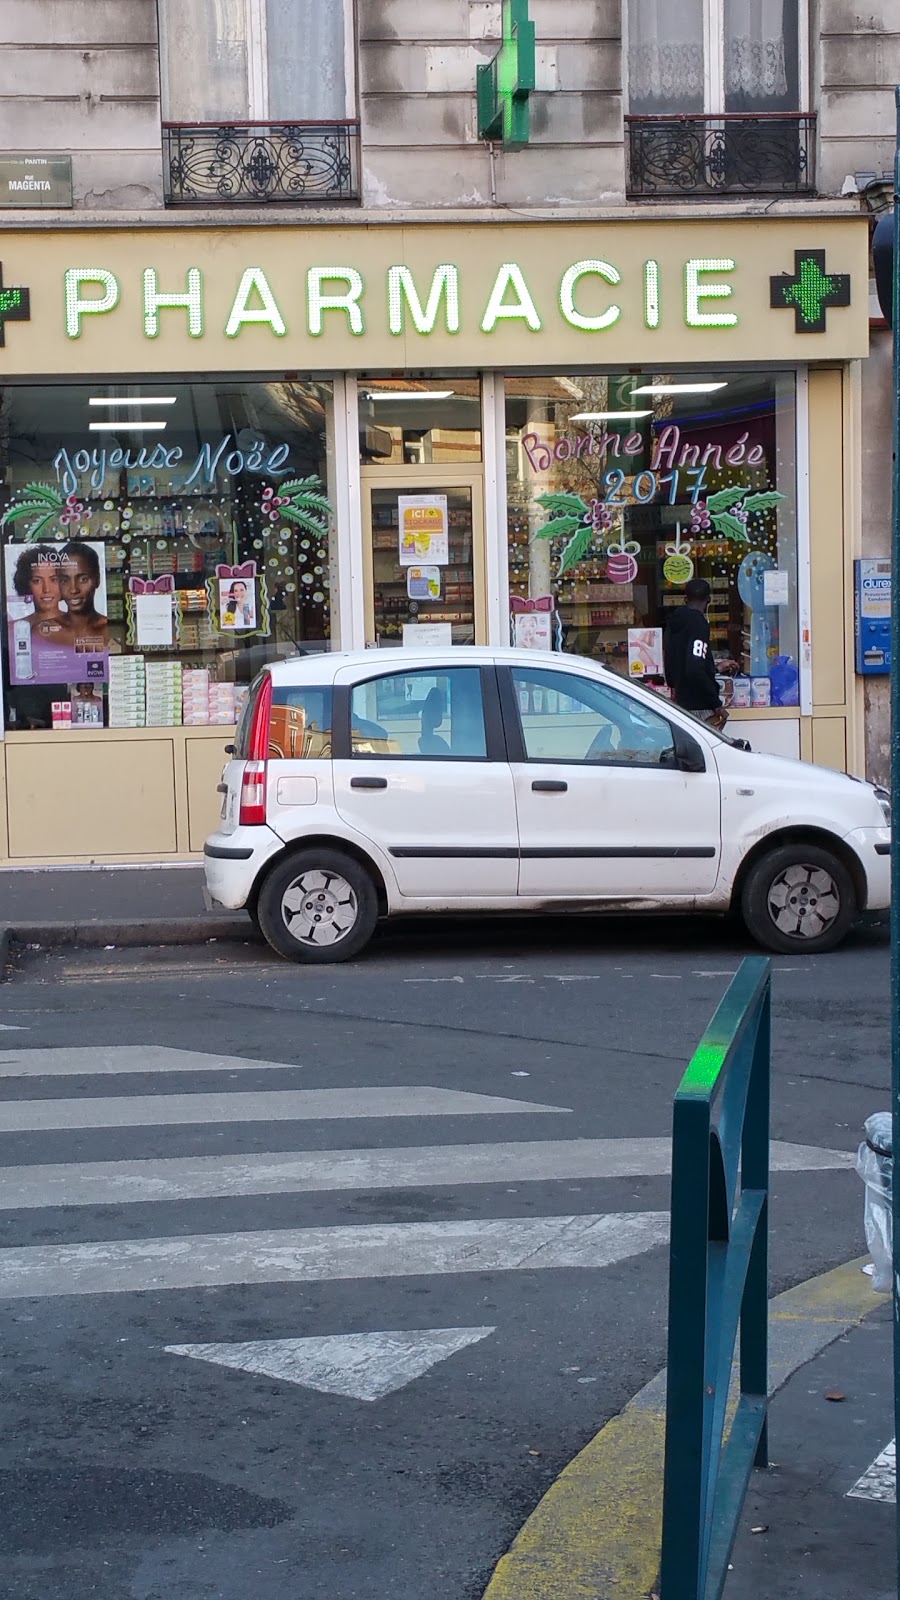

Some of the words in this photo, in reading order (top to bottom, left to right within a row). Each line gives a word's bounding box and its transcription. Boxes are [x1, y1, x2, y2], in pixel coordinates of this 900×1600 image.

[8, 180, 51, 191] MAGENTA
[64, 258, 739, 339] PHARMACIE
[54, 442, 183, 496] Joyeuse
[184, 434, 296, 486] Noël
[522, 431, 645, 474] Bonne
[651, 424, 767, 471] Année
[602, 465, 708, 505] 2017
[411, 509, 425, 518] ICI
